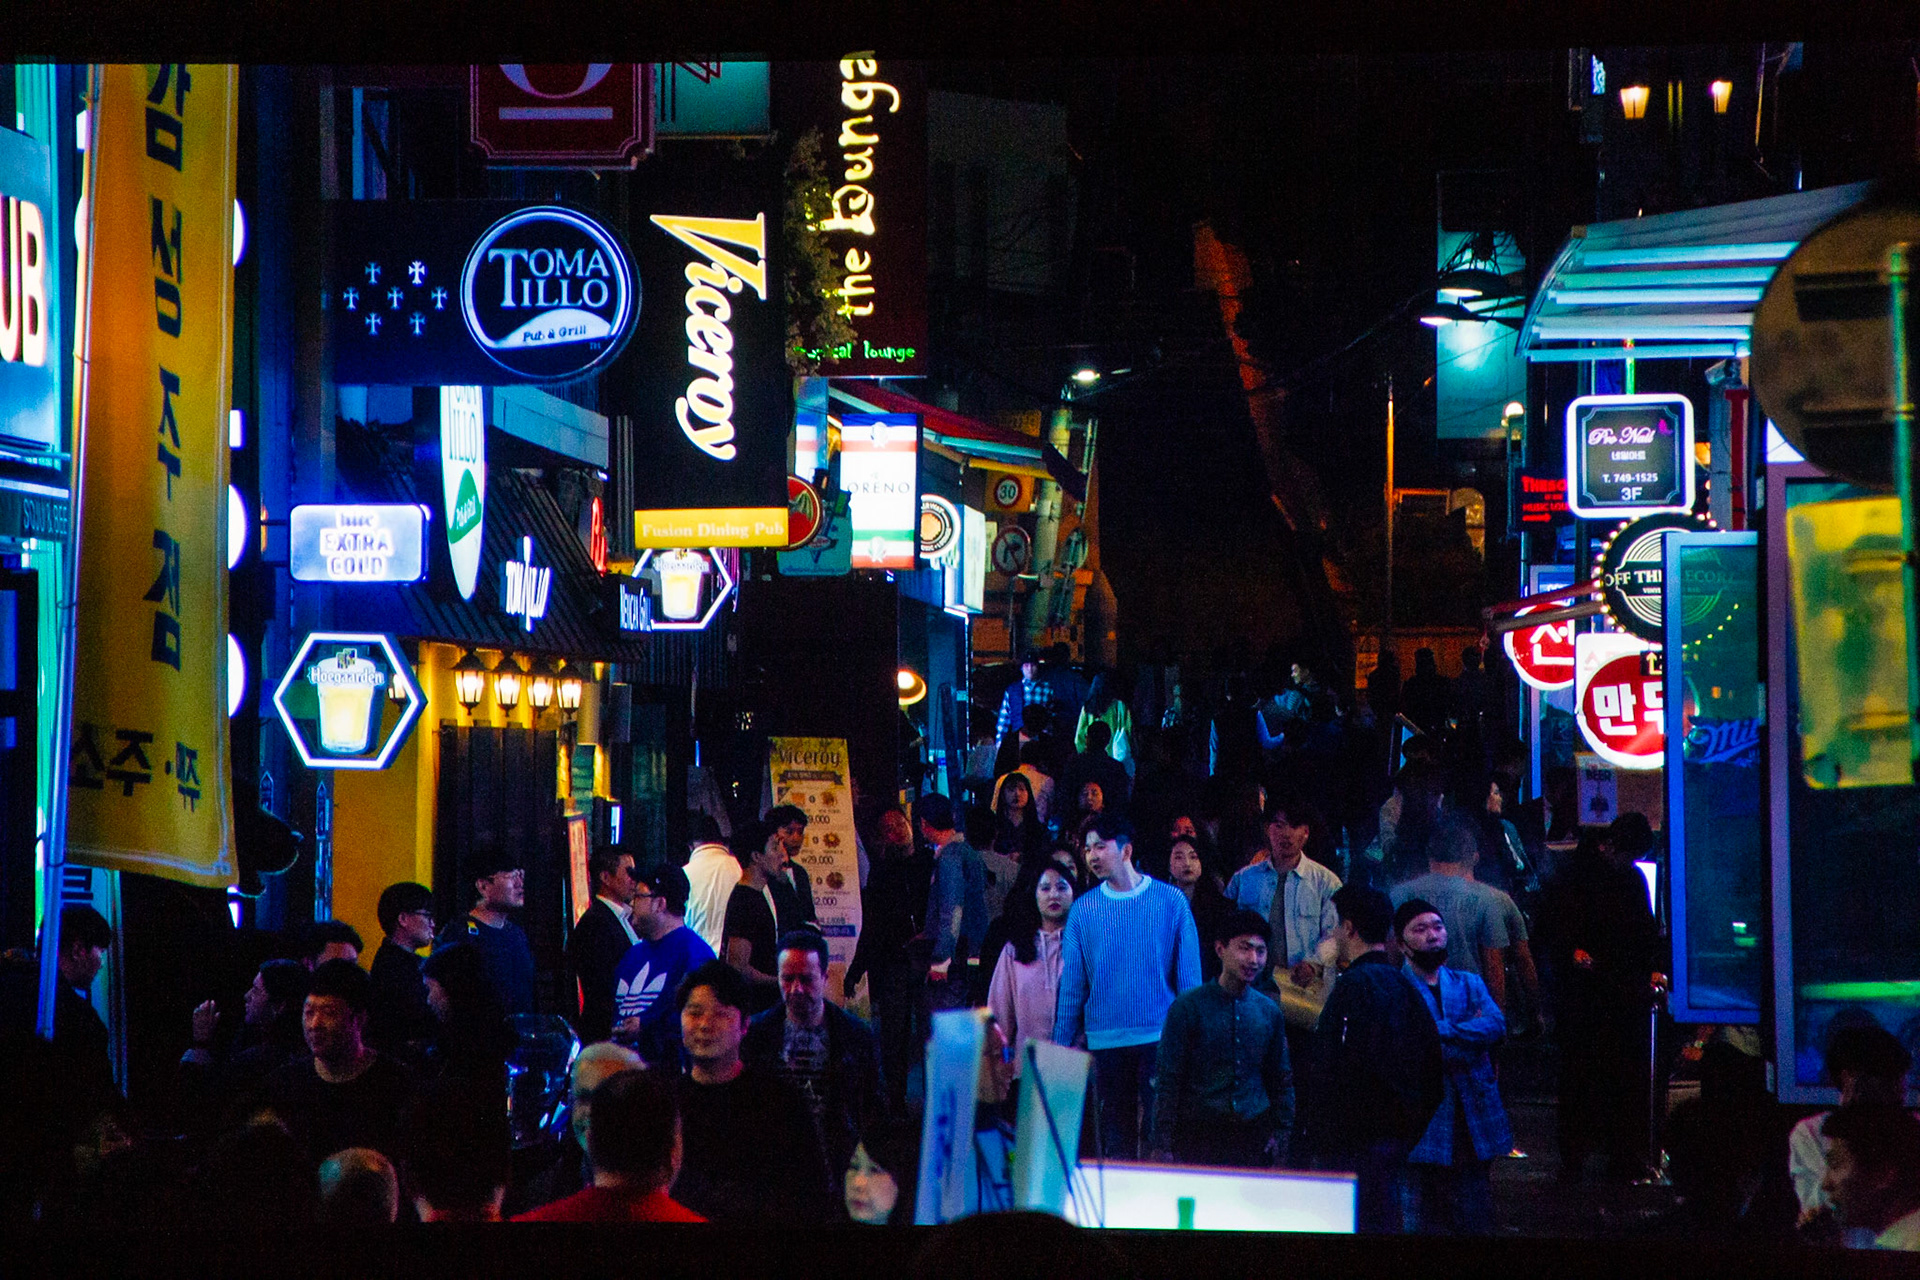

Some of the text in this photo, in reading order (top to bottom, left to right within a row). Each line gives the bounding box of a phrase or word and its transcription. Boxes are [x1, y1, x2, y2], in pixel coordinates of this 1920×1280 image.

[837, 248, 875, 320] the
[558, 325, 587, 337] Grill
[650, 212, 766, 461] Viceroy
[863, 340, 916, 362] lounge
[1588, 426, 1656, 446] Pro Nail
[1614, 473, 1658, 483] 749-1525
[847, 481, 910, 494] ORENO
[997, 484, 1017, 500] 30
[1621, 486, 1643, 500] 3F
[642, 522, 785, 539] Fusion Dining Pub
[325, 533, 389, 552] EXTRA
[1604, 571, 1631, 587] OFF
[310, 667, 384, 685] Hoegaarden
[780, 748, 840, 767] Viceroy
